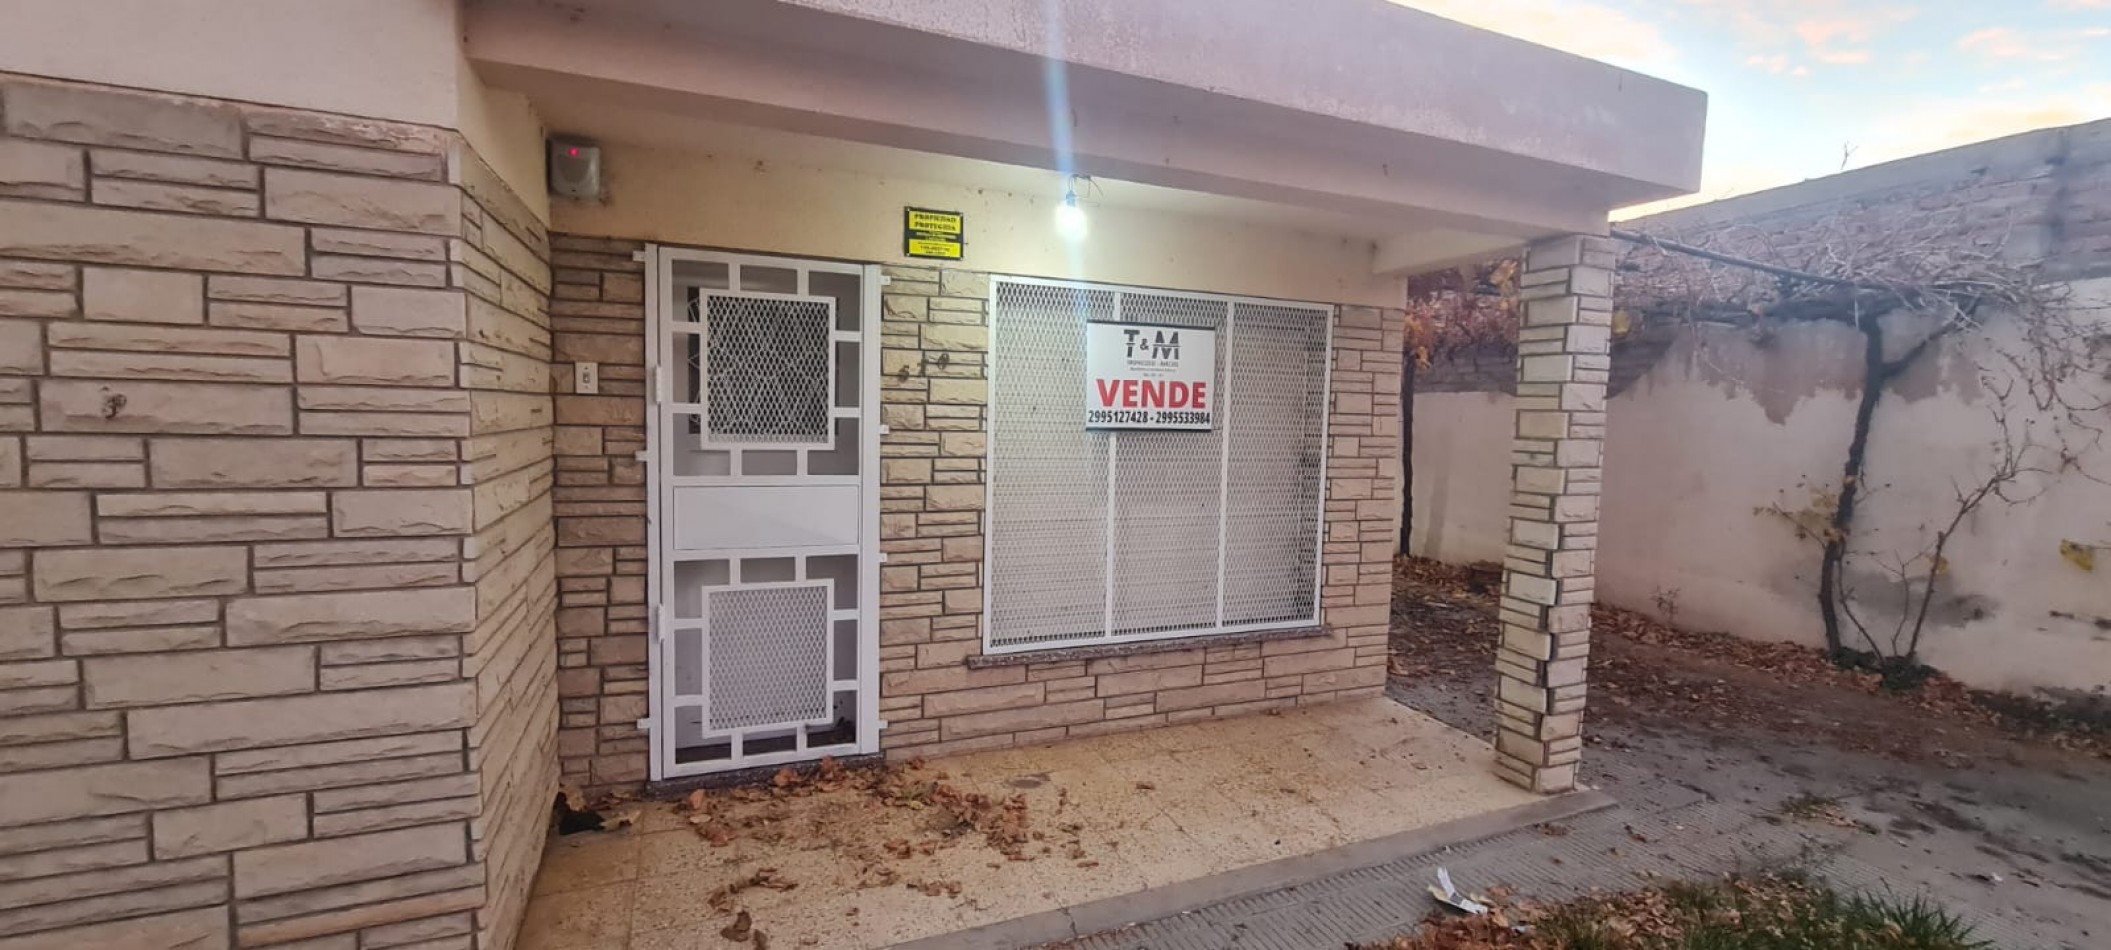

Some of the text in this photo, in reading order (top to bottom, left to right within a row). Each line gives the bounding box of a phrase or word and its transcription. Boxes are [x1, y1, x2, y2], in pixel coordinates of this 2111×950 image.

[914, 214, 956, 223] PROPIEDAD
[914, 222, 956, 231] PROTEGIDA
[1096, 379, 1207, 409] VENDE
[1088, 410, 1149, 423] 2995127428
[1155, 411, 1211, 424] 2995533984
